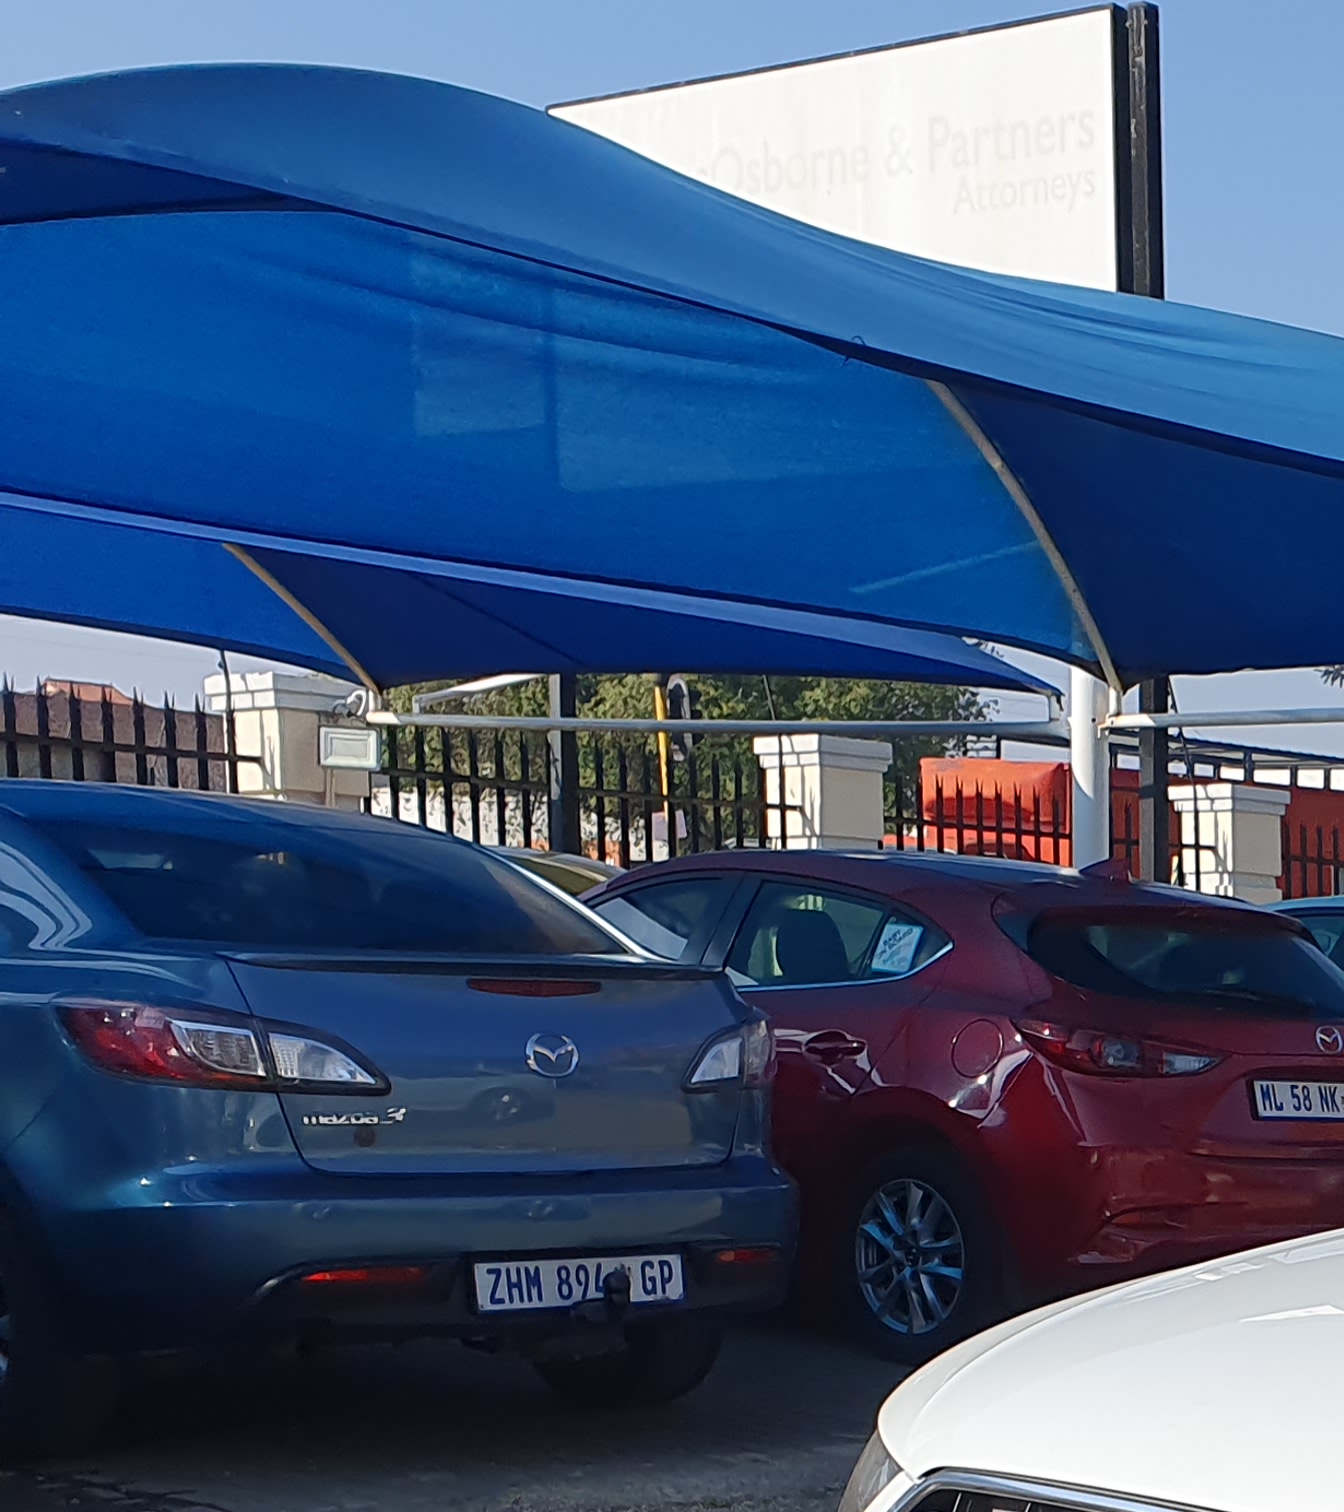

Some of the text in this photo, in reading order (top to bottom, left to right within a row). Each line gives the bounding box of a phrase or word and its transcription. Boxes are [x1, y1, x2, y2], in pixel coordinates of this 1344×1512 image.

[712, 107, 1096, 197] Osborne & Partners
[953, 166, 1096, 216] Attorneys
[1260, 1083, 1284, 1112] ML
[1290, 1084, 1313, 1112] 58
[1318, 1085, 1341, 1113] NK
[485, 1264, 544, 1305] ZHM
[640, 1259, 674, 1297] GP
